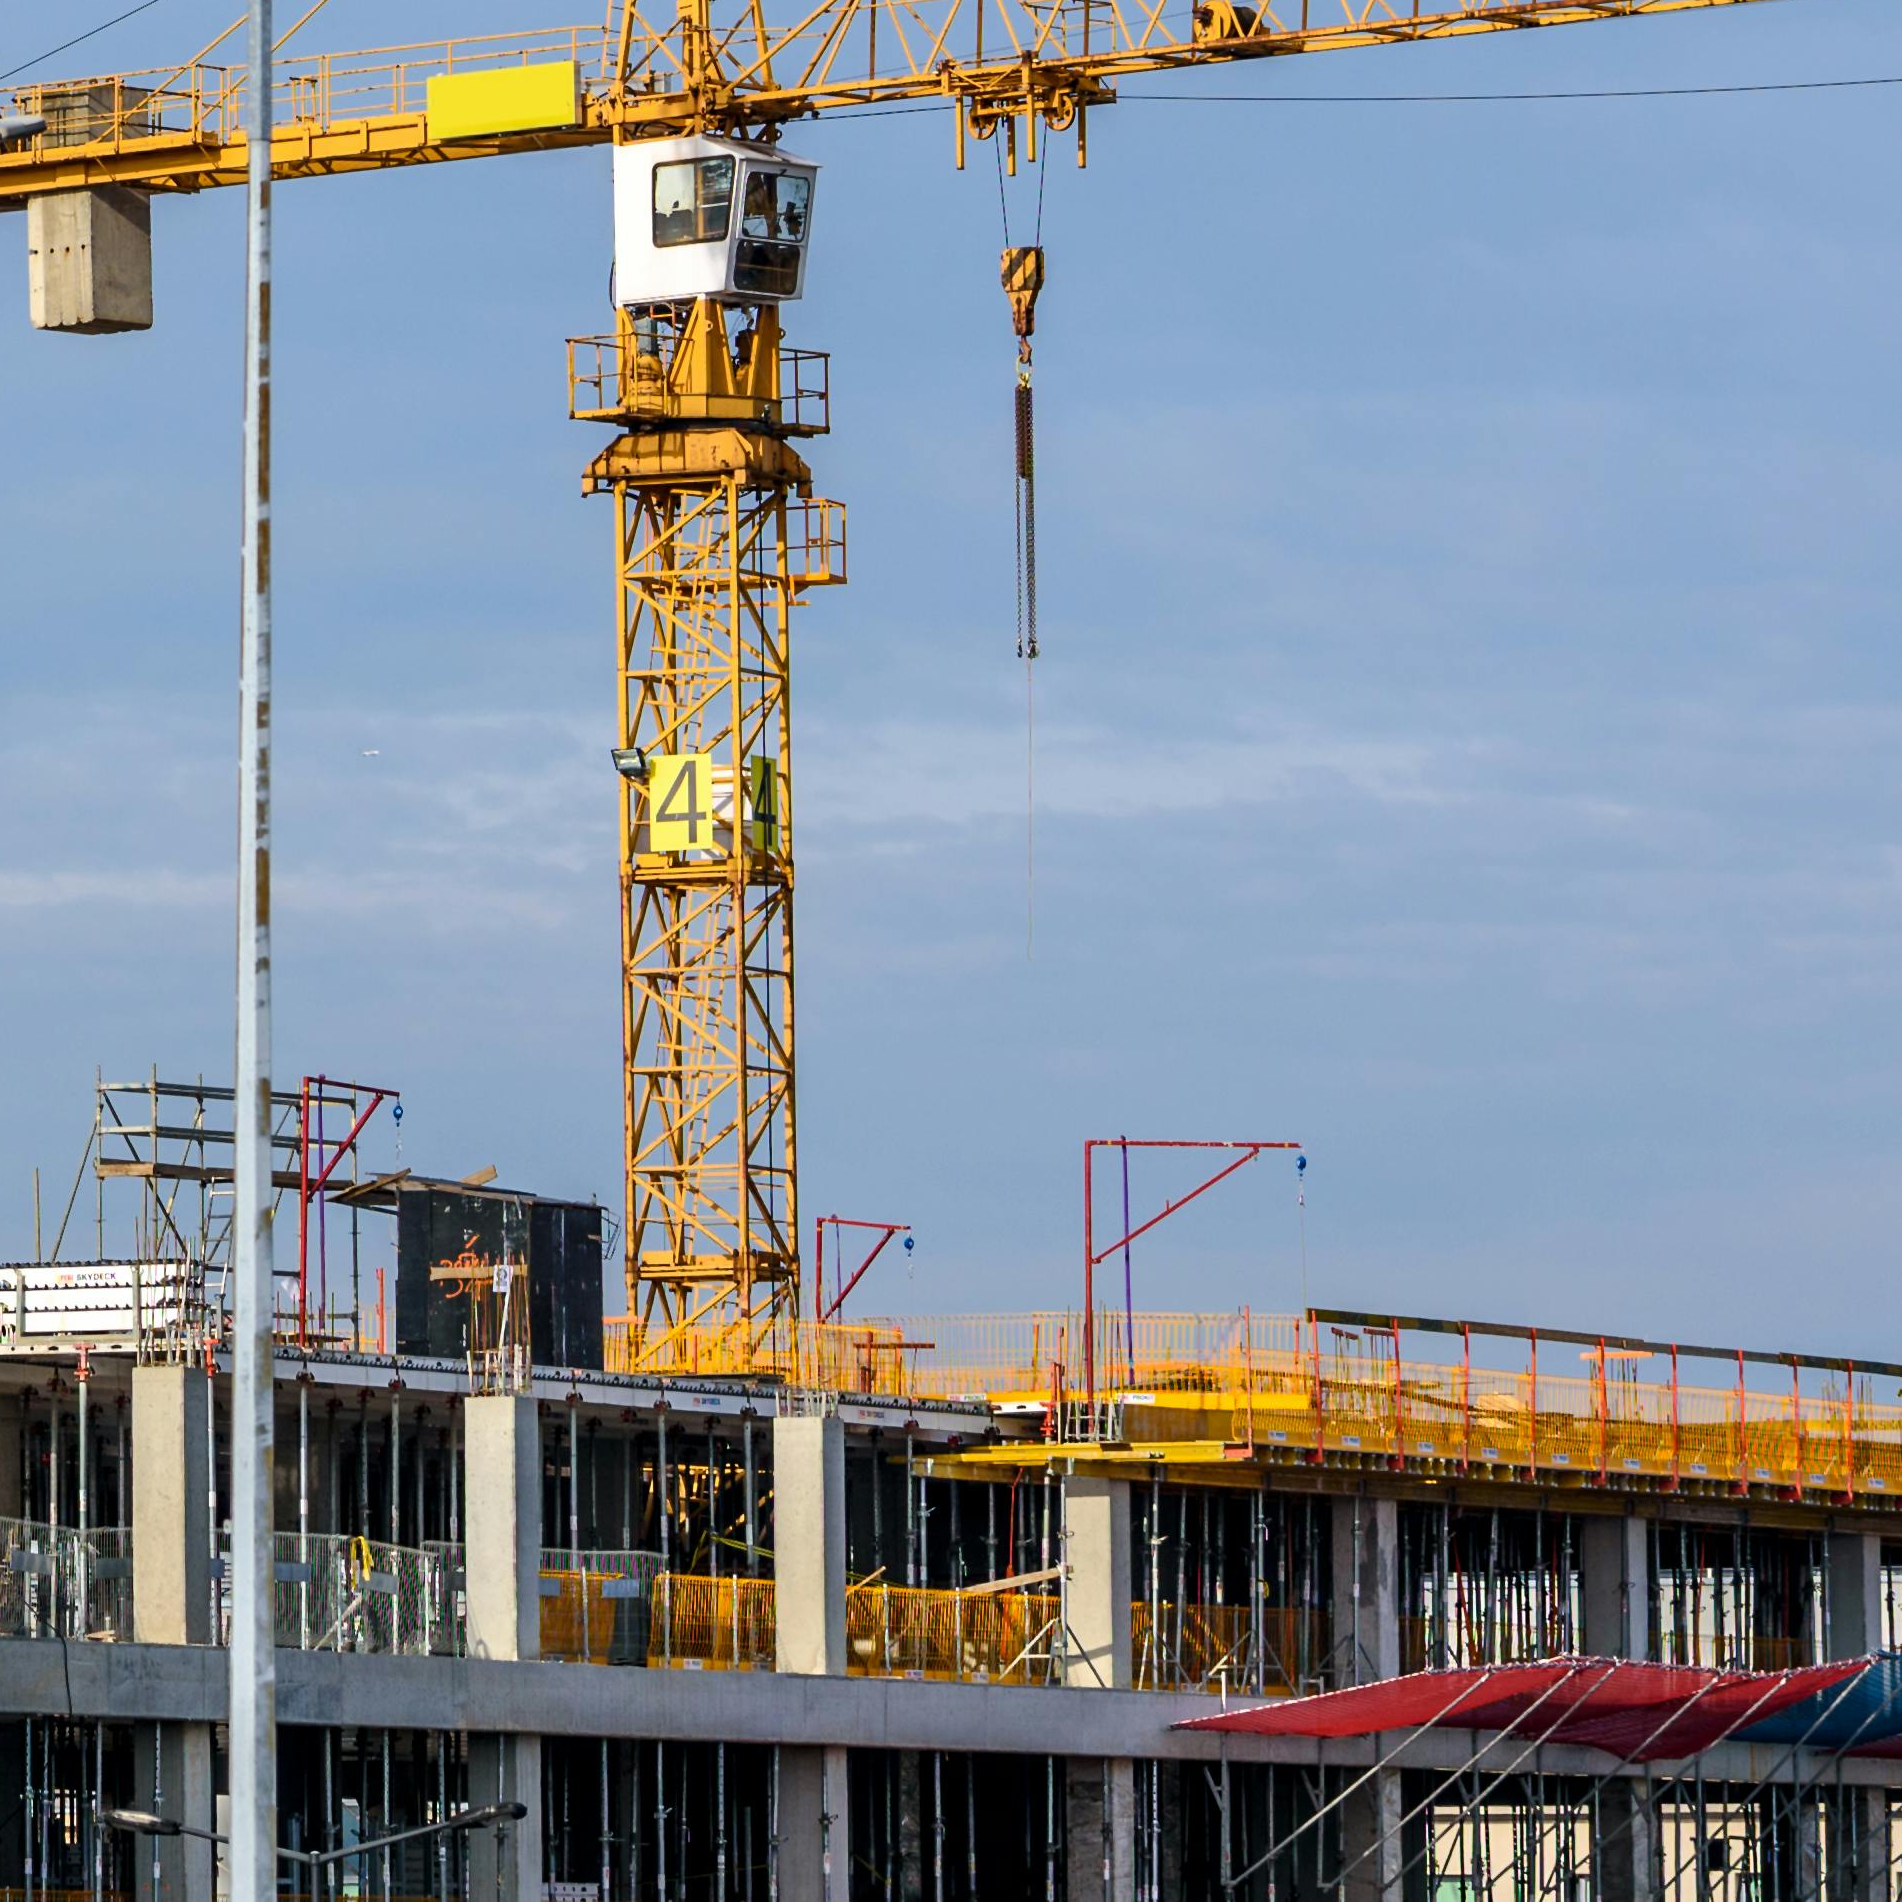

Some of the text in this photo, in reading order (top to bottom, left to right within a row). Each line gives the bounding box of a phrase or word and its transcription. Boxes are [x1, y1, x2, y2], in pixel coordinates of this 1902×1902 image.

[656, 760, 707, 843] 4
[754, 762, 777, 846] 4
[76, 1272, 116, 1281] SKYDECK
